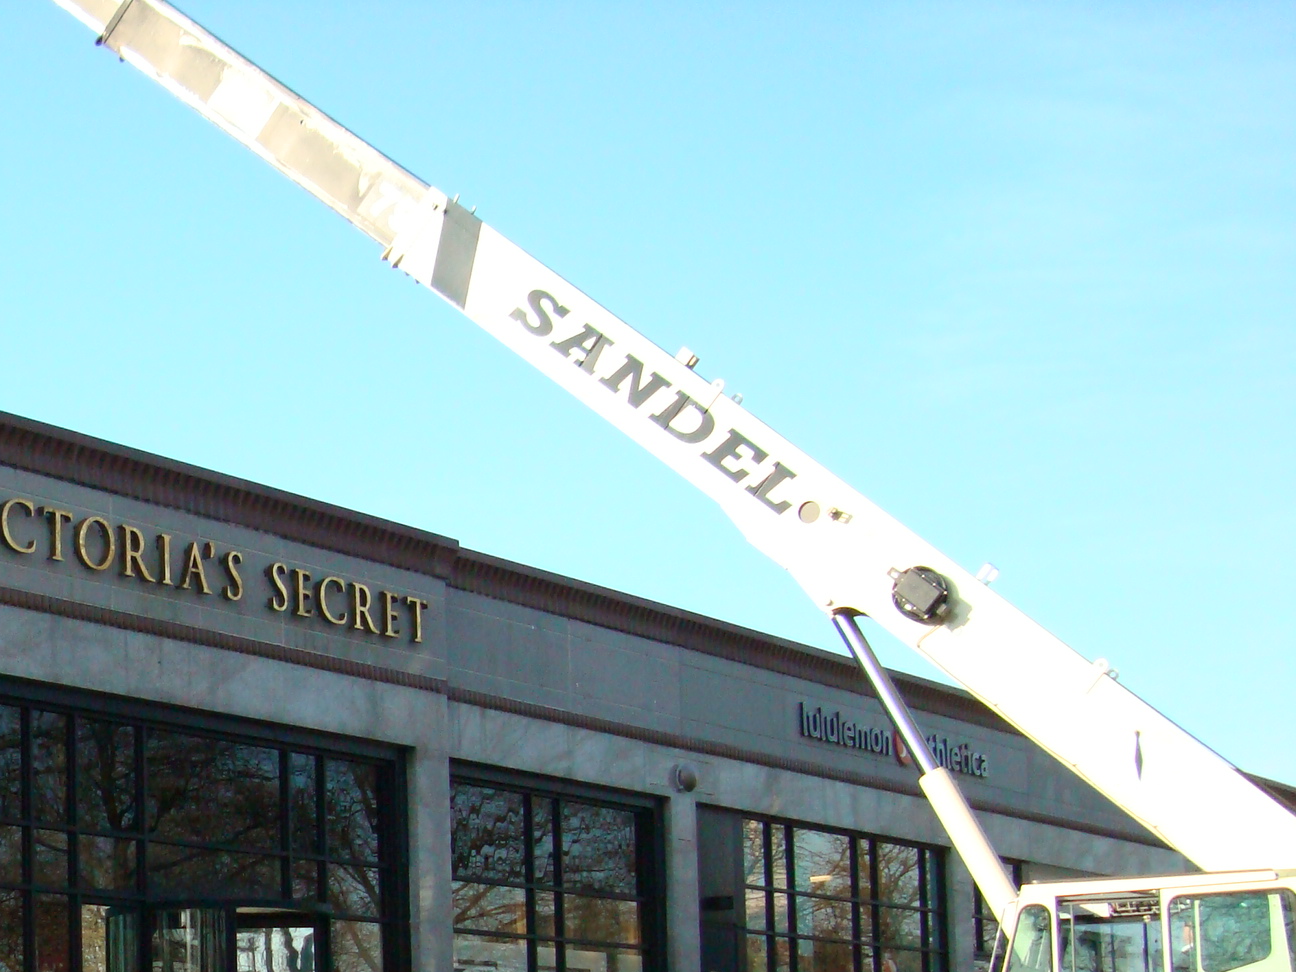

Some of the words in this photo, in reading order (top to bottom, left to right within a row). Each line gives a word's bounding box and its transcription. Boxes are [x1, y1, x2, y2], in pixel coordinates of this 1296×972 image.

[508, 289, 797, 515] SANDEL
[267, 561, 429, 643] SECRET
[799, 701, 892, 756] lululemon
[926, 734, 989, 778] thletica
